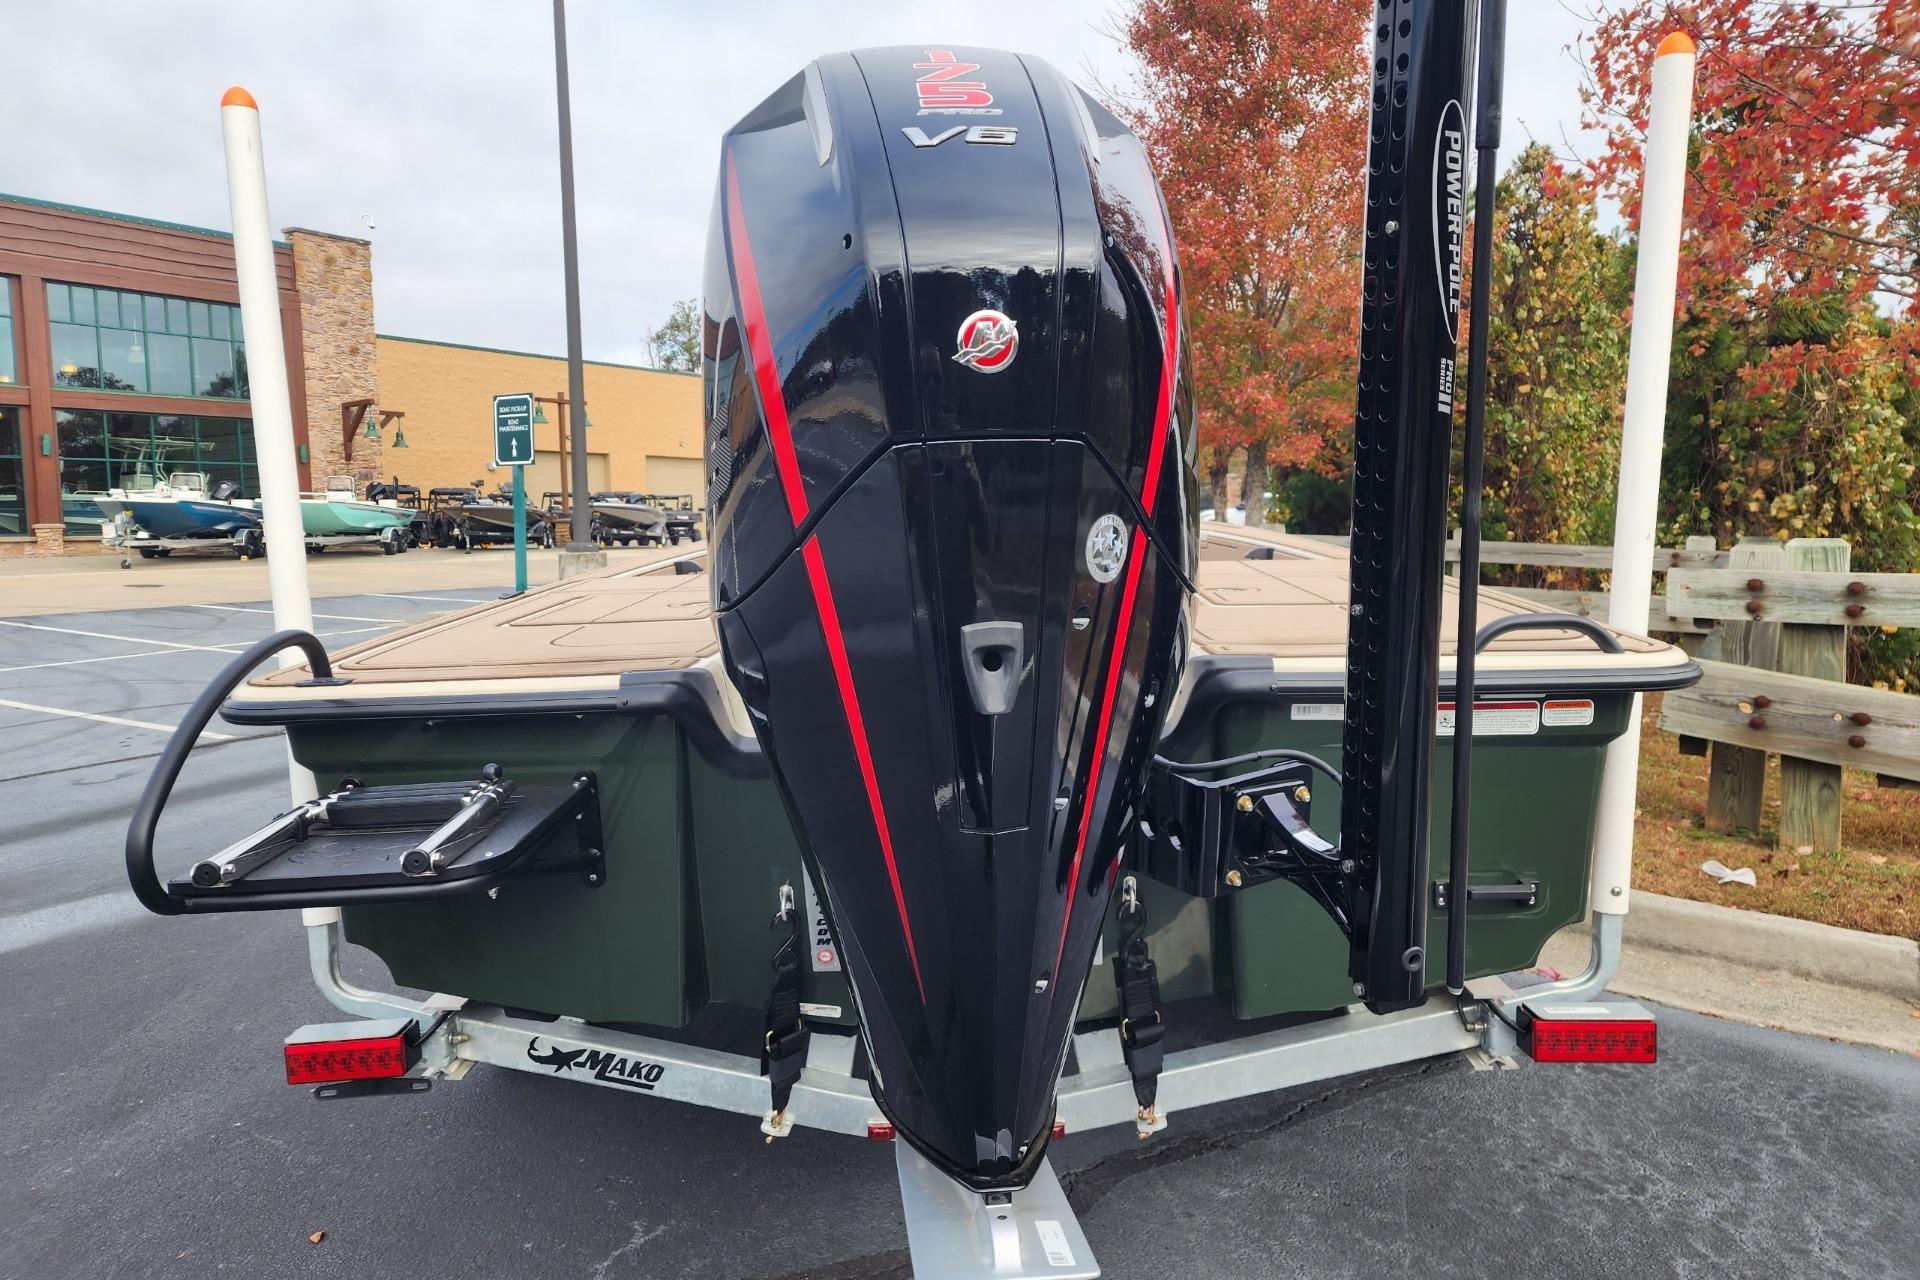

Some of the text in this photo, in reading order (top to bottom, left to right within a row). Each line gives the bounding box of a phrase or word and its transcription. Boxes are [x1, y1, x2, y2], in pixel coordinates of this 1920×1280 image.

[916, 108, 1003, 116] PRO
[901, 125, 1018, 148] V6
[1444, 129, 1462, 314] POWER-POLE
[1446, 359, 1454, 394] PRO
[1438, 391, 1452, 415] II
[573, 1048, 665, 1090] MAKO
